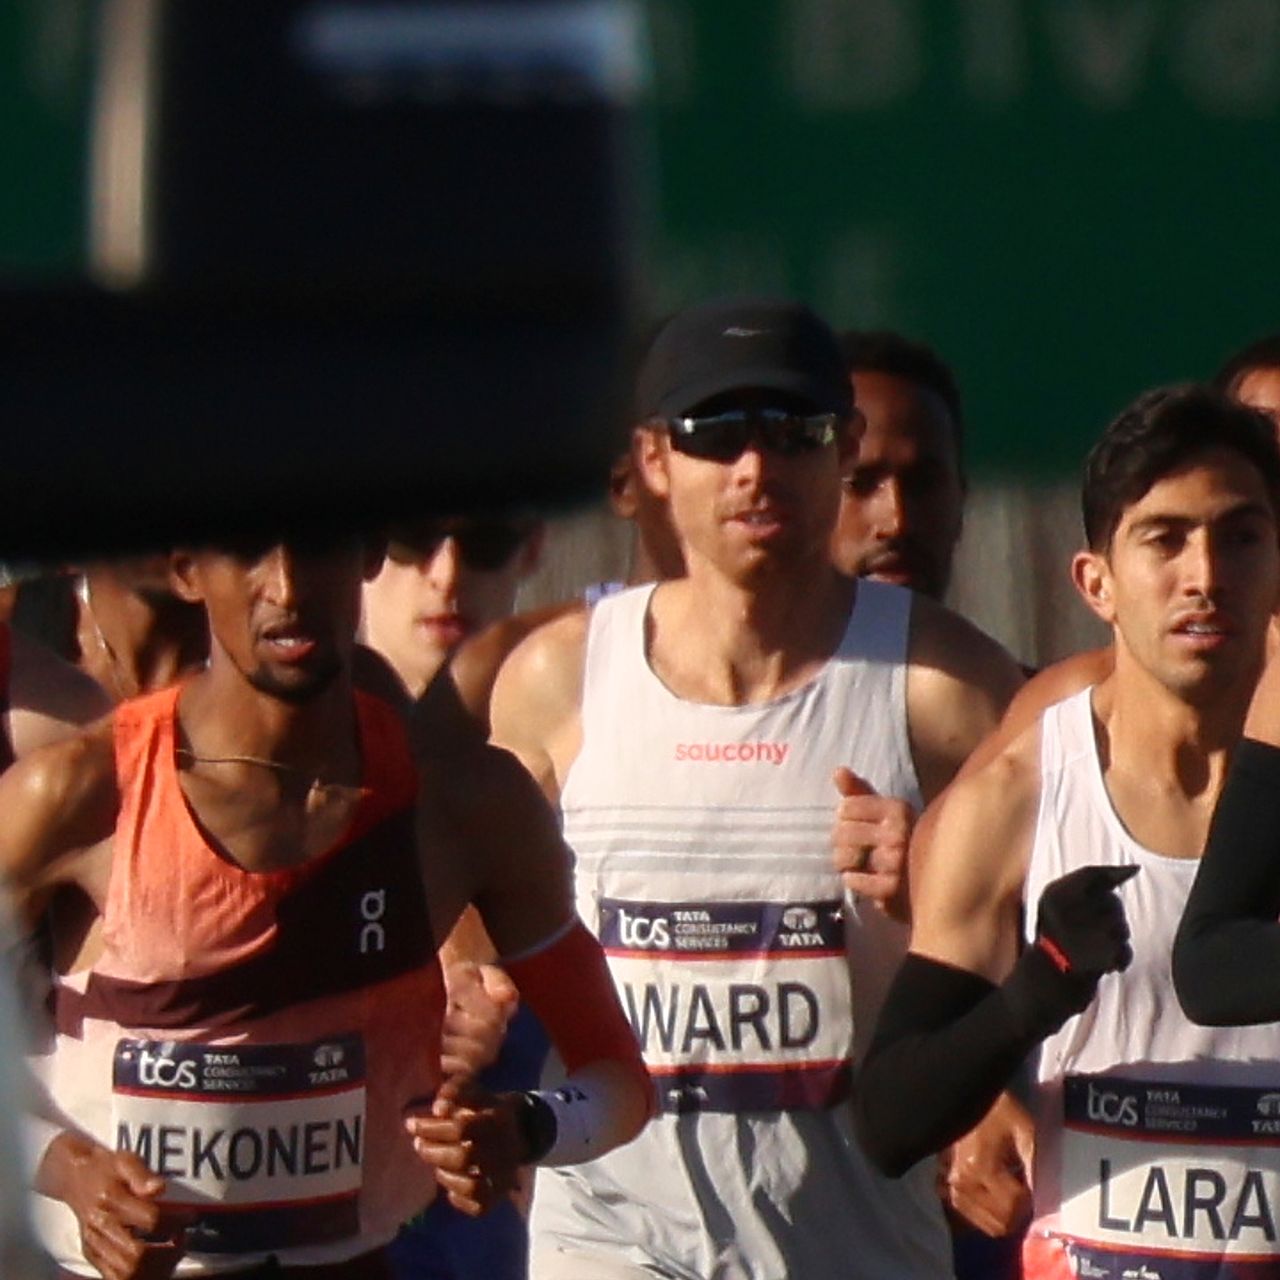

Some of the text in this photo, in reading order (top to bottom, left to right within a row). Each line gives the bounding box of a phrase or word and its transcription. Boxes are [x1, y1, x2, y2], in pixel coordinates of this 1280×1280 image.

[674, 740, 788, 765] saucony
[618, 908, 670, 948] tcs
[673, 911, 711, 922] TATA
[779, 933, 825, 947] TATA
[623, 980, 820, 1053] WARD
[138, 1050, 198, 1089] tcs
[203, 1053, 240, 1067] TATA
[307, 1068, 349, 1085] TATA
[1087, 1082, 1139, 1126] tcs
[117, 1114, 362, 1182] MEKONEN
[1097, 1157, 1277, 1243] LARA
